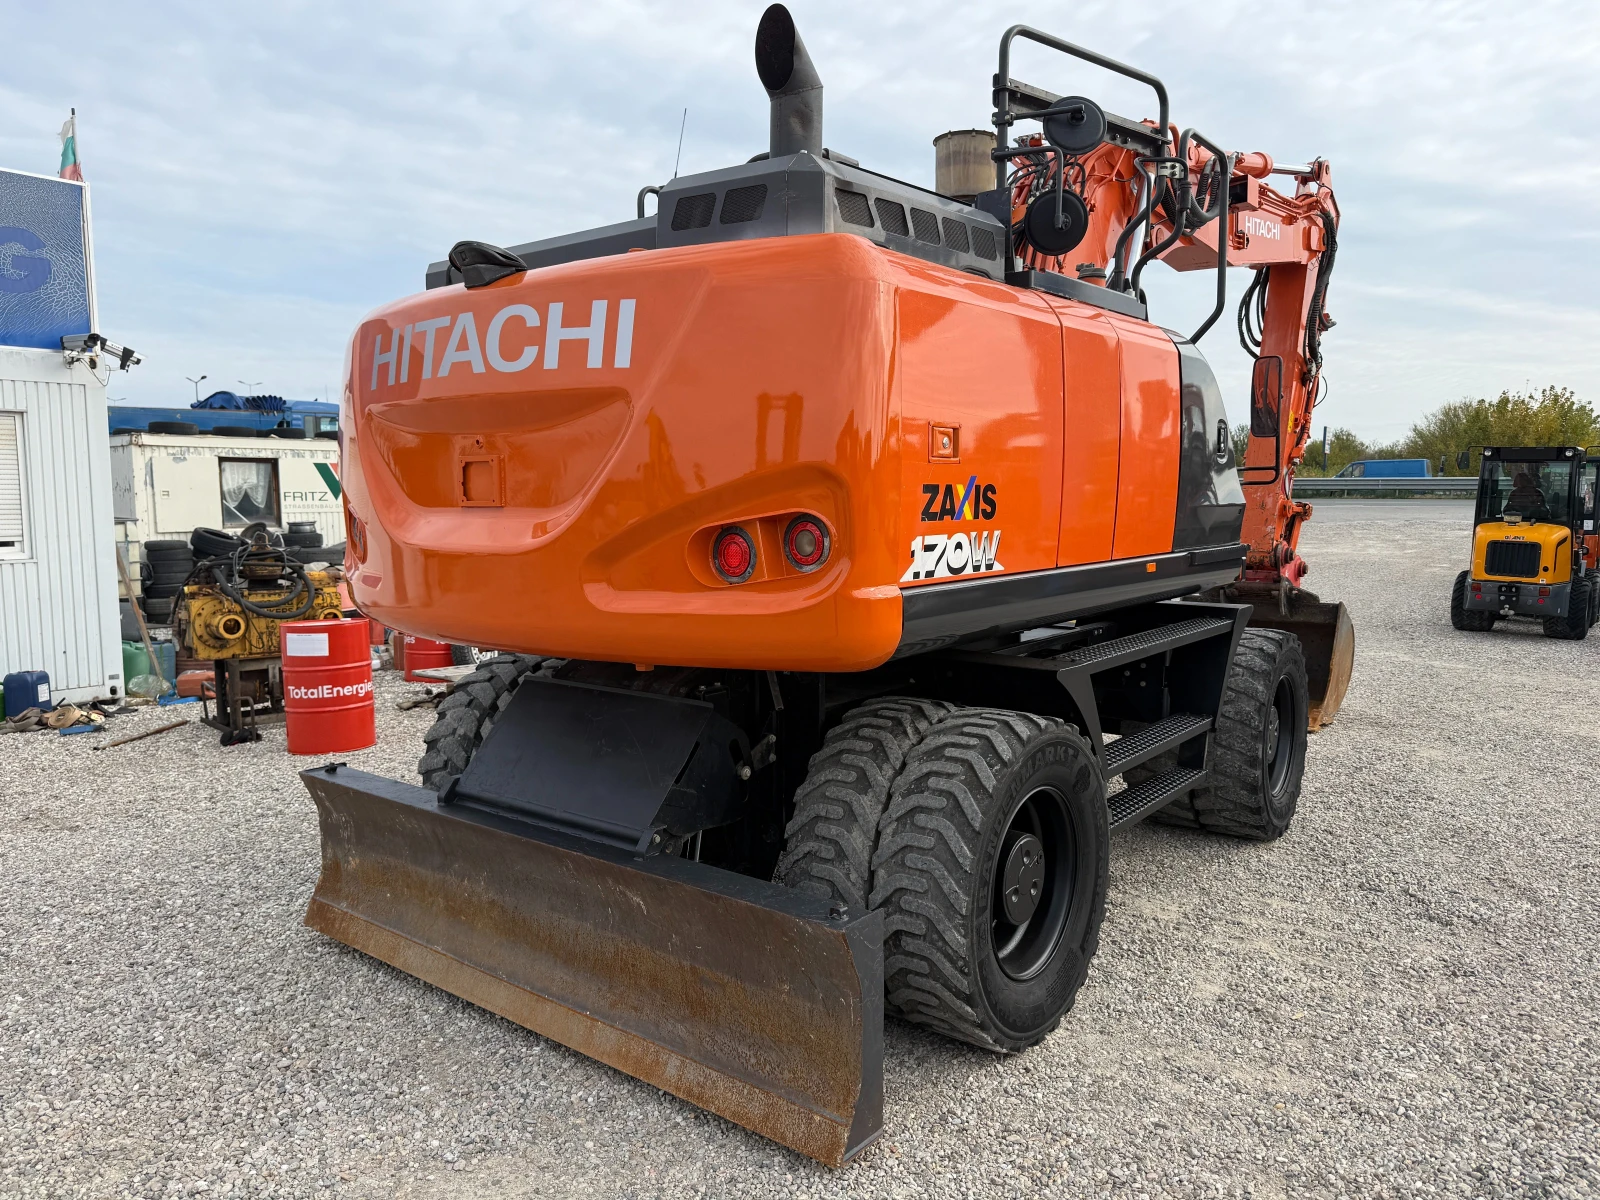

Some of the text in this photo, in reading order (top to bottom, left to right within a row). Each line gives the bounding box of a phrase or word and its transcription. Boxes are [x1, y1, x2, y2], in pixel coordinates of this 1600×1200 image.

[1245, 215, 1280, 240] HITACHI
[370, 298, 636, 391] HITACHI
[283, 491, 329, 502] FRITZ
[920, 475, 997, 522] ZAXIS
[901, 530, 1004, 582] 170W
